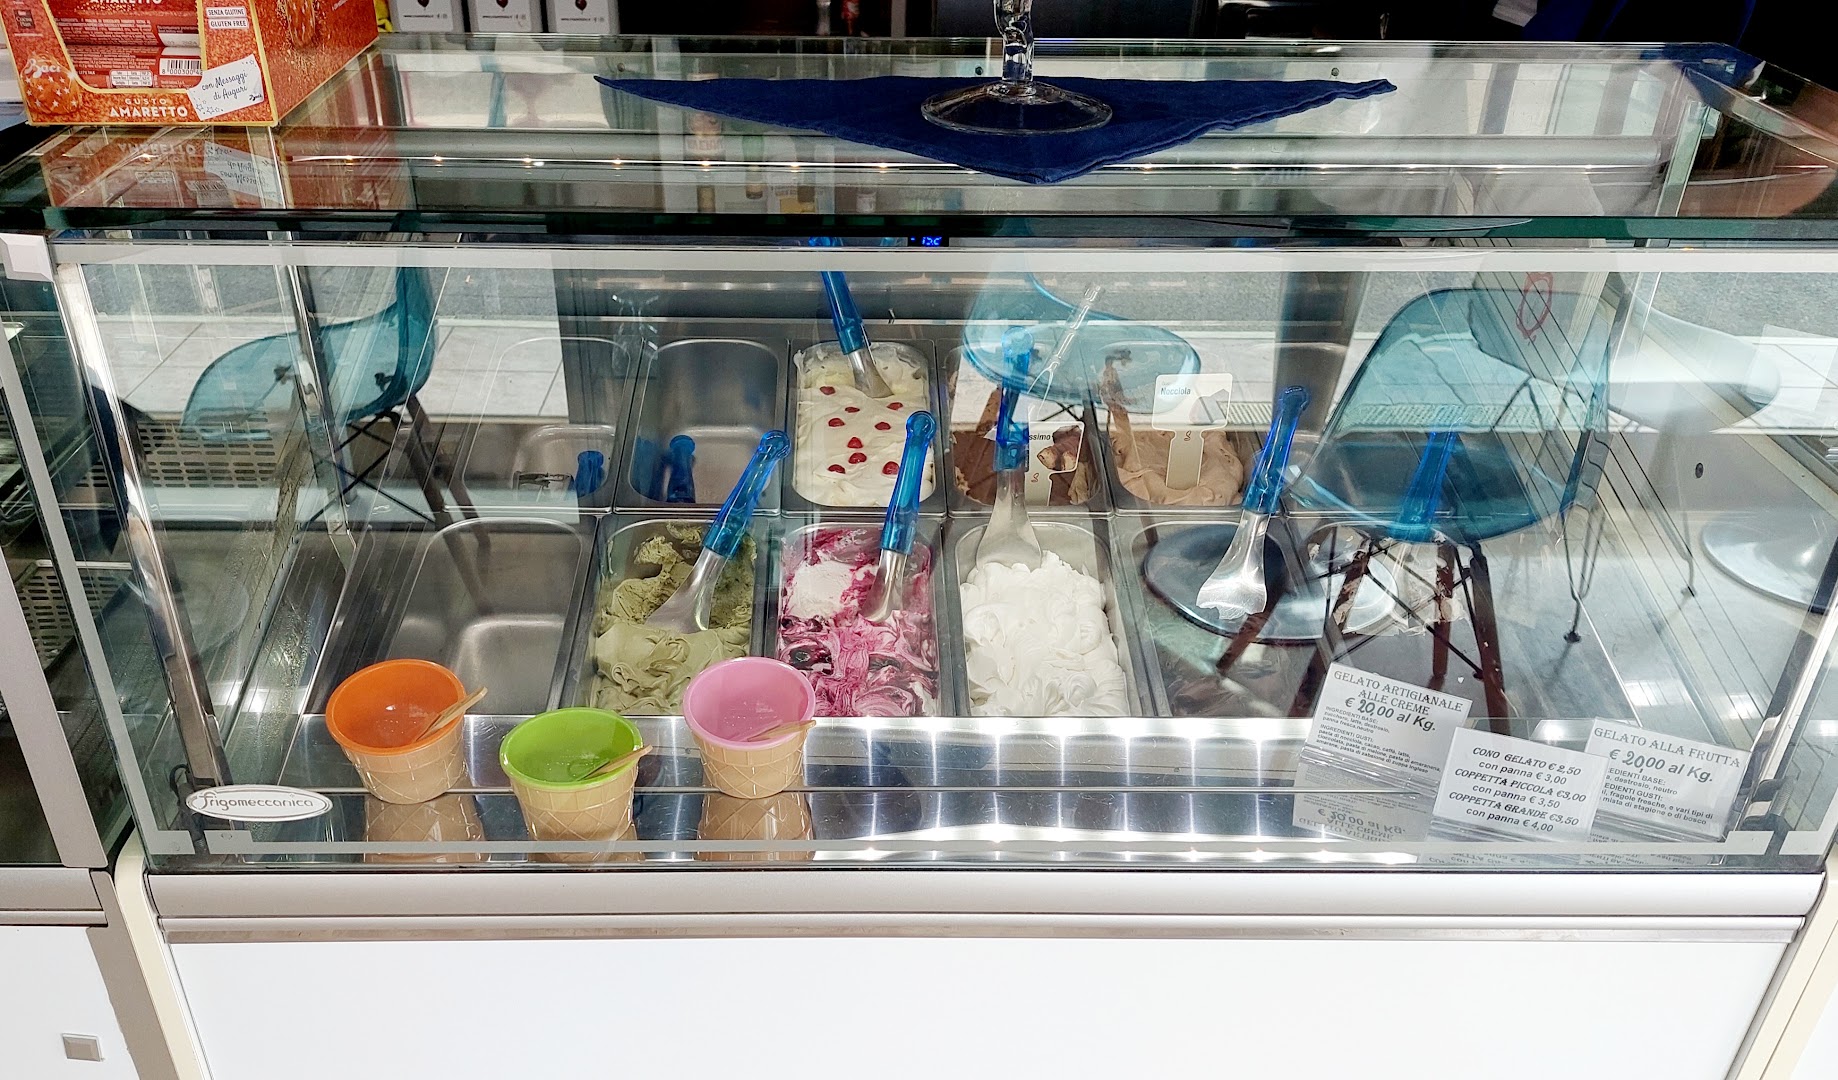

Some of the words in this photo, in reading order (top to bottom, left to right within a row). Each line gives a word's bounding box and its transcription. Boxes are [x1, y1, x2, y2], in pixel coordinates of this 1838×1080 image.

[24, 57, 61, 78] Baci
[201, 82, 215, 91] con
[215, 70, 249, 89] Messaggi
[213, 91, 222, 101] di
[222, 86, 248, 101] Auguri
[109, 106, 188, 118] AMARETTO
[1160, 387, 1191, 396] Nocciola
[1029, 433, 1051, 441] ssimo
[1334, 670, 1381, 690] GELATO
[1381, 684, 1464, 713] ARTIGIANALE
[1358, 689, 1389, 704] ALLE
[1390, 697, 1430, 716] CREME
[1325, 706, 1361, 720] INGREDIENTI
[1345, 697, 1356, 708] €
[1357, 699, 1395, 719] 20,00
[1396, 713, 1411, 724] al
[1413, 715, 1436, 732] Kg.
[1320, 724, 1355, 737] INGREDIENTI
[1594, 727, 1647, 747] GELATO
[1649, 739, 1685, 756] ALLA
[1688, 748, 1741, 768] FRUTTA
[1472, 746, 1500, 759] CONO
[1504, 753, 1547, 769] GELATO
[1548, 762, 1557, 771] €
[1557, 764, 1582, 776] 2,50
[1478, 760, 1499, 771] con
[1499, 765, 1533, 778] panna
[1535, 771, 1544, 780] €
[1544, 773, 1567, 785] 3,00
[1609, 749, 1621, 760] €
[1668, 763, 1686, 775] al
[1687, 765, 1713, 783] Kg.
[1455, 768, 1508, 786] COPPETTA
[1509, 779, 1554, 797] PICCOLA
[1608, 767, 1640, 780] EDIENTI
[1641, 774, 1666, 786] BASE:
[1614, 776, 1651, 790] destrosio,
[1653, 785, 1678, 795] neutro
[199, 791, 314, 811] frigomeccanica
[1472, 784, 1493, 794] con
[1493, 789, 1527, 802] panna
[1529, 795, 1537, 804] €
[1538, 797, 1561, 809] 3,50
[1604, 782, 1636, 795] EDIENTI
[1636, 790, 1663, 802] GUSTI:
[1609, 790, 1636, 802] fragole
[1637, 797, 1667, 810] fresche,
[1675, 806, 1690, 815] vari
[1691, 809, 1704, 818] tipi
[1449, 791, 1502, 810] COPPETTA
[1504, 802, 1548, 820] GRANDE
[1602, 796, 1623, 806] mista
[1633, 804, 1666, 816] stagione
[1683, 814, 1707, 825] bosco
[1466, 807, 1486, 818] con
[1486, 812, 1520, 825] panna
[1522, 819, 1531, 827] €
[1531, 820, 1554, 832] 4,00
